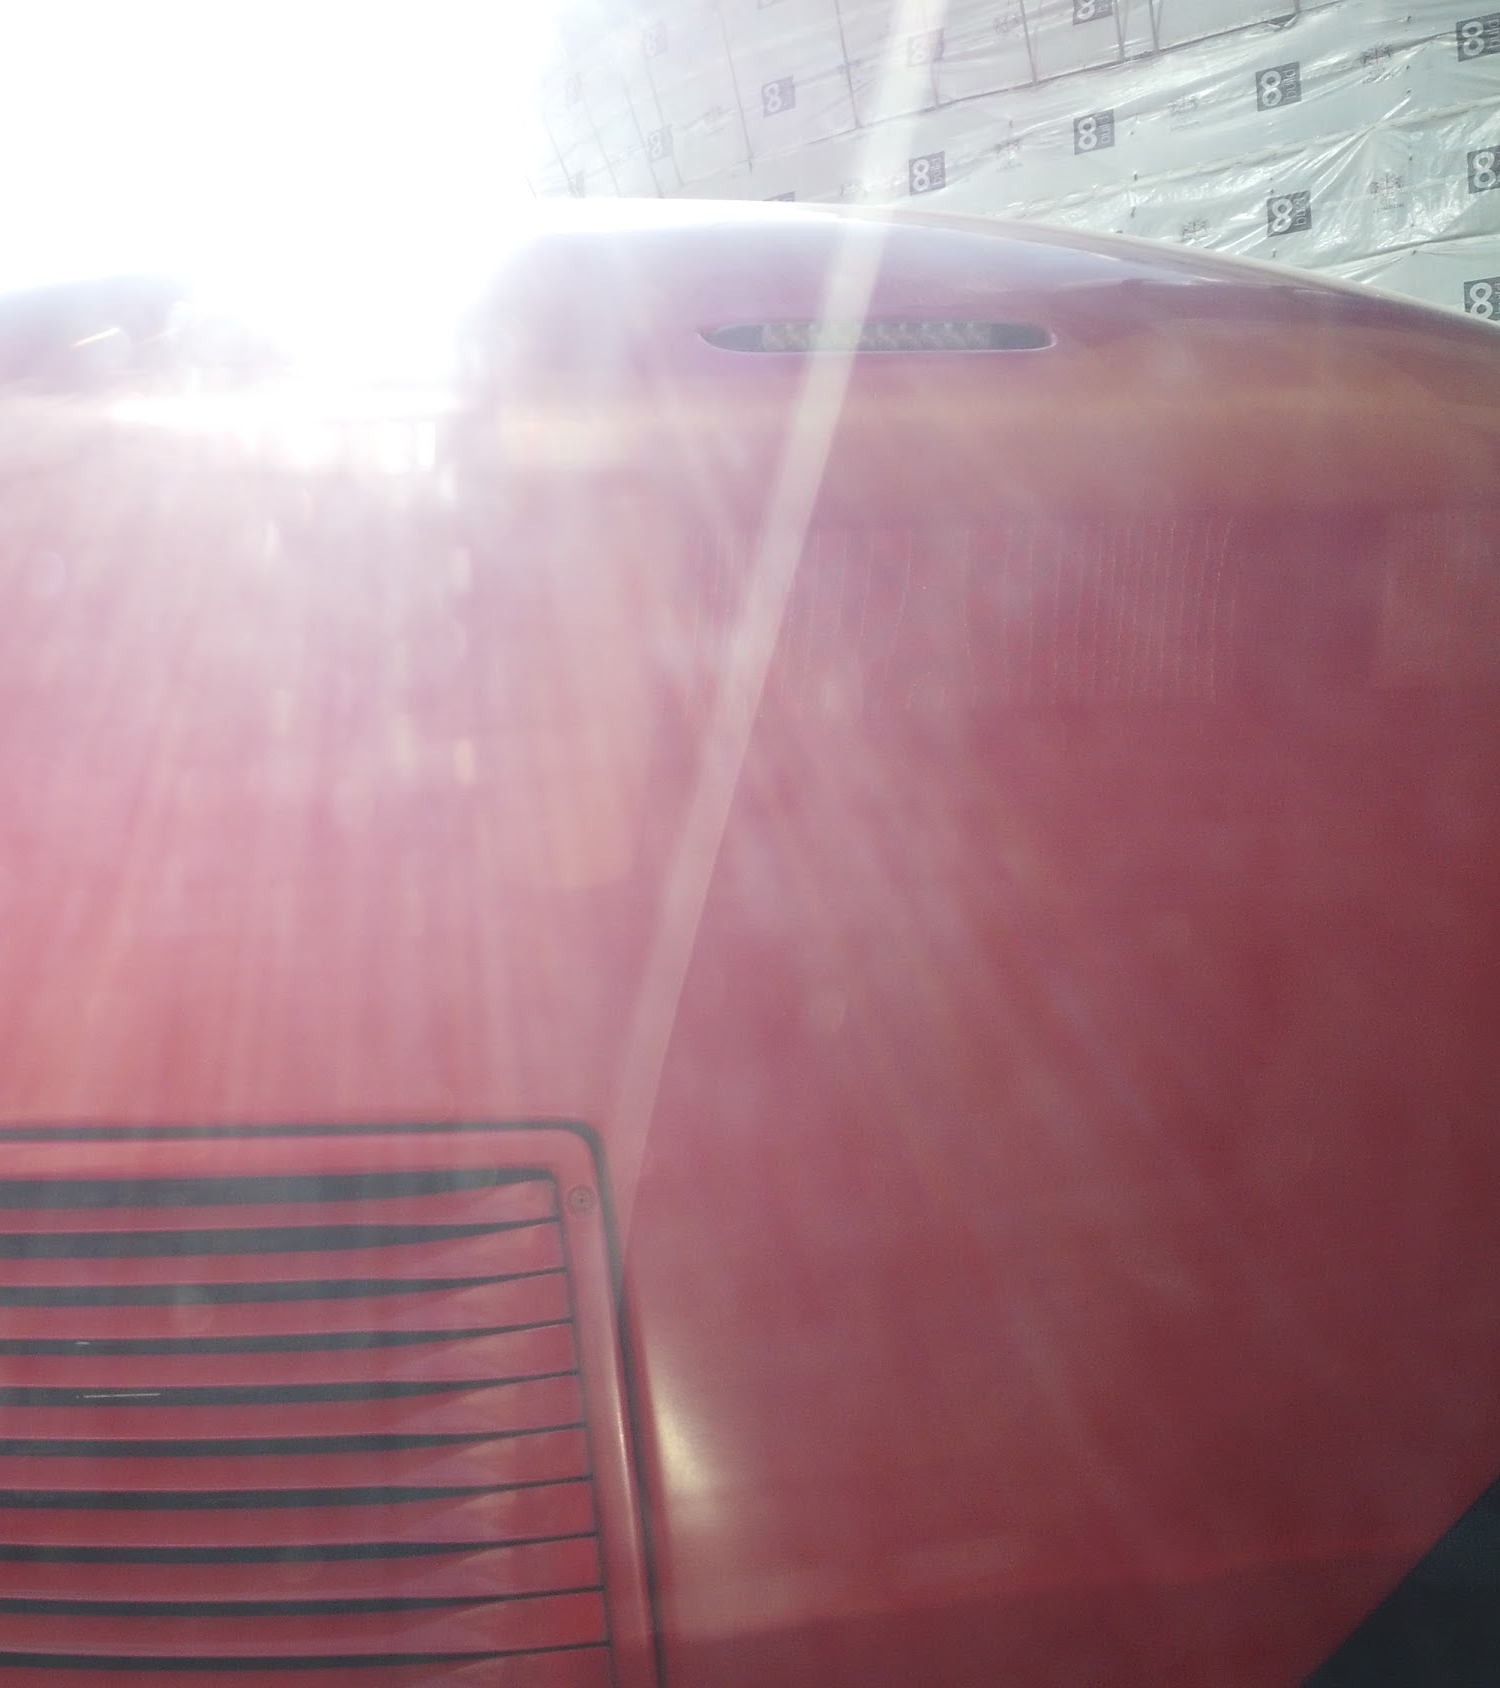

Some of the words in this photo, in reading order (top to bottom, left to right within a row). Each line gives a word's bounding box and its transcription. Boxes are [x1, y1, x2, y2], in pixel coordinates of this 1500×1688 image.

[1462, 21, 1484, 56] 8
[764, 83, 781, 112] 8
[1260, 70, 1282, 106] 8
[1283, 68, 1297, 99] build
[1077, 117, 1098, 150] 8
[912, 159, 930, 192] 8
[1473, 151, 1496, 188] 8
[1272, 199, 1293, 232] 8
[1469, 282, 1493, 320] 8
